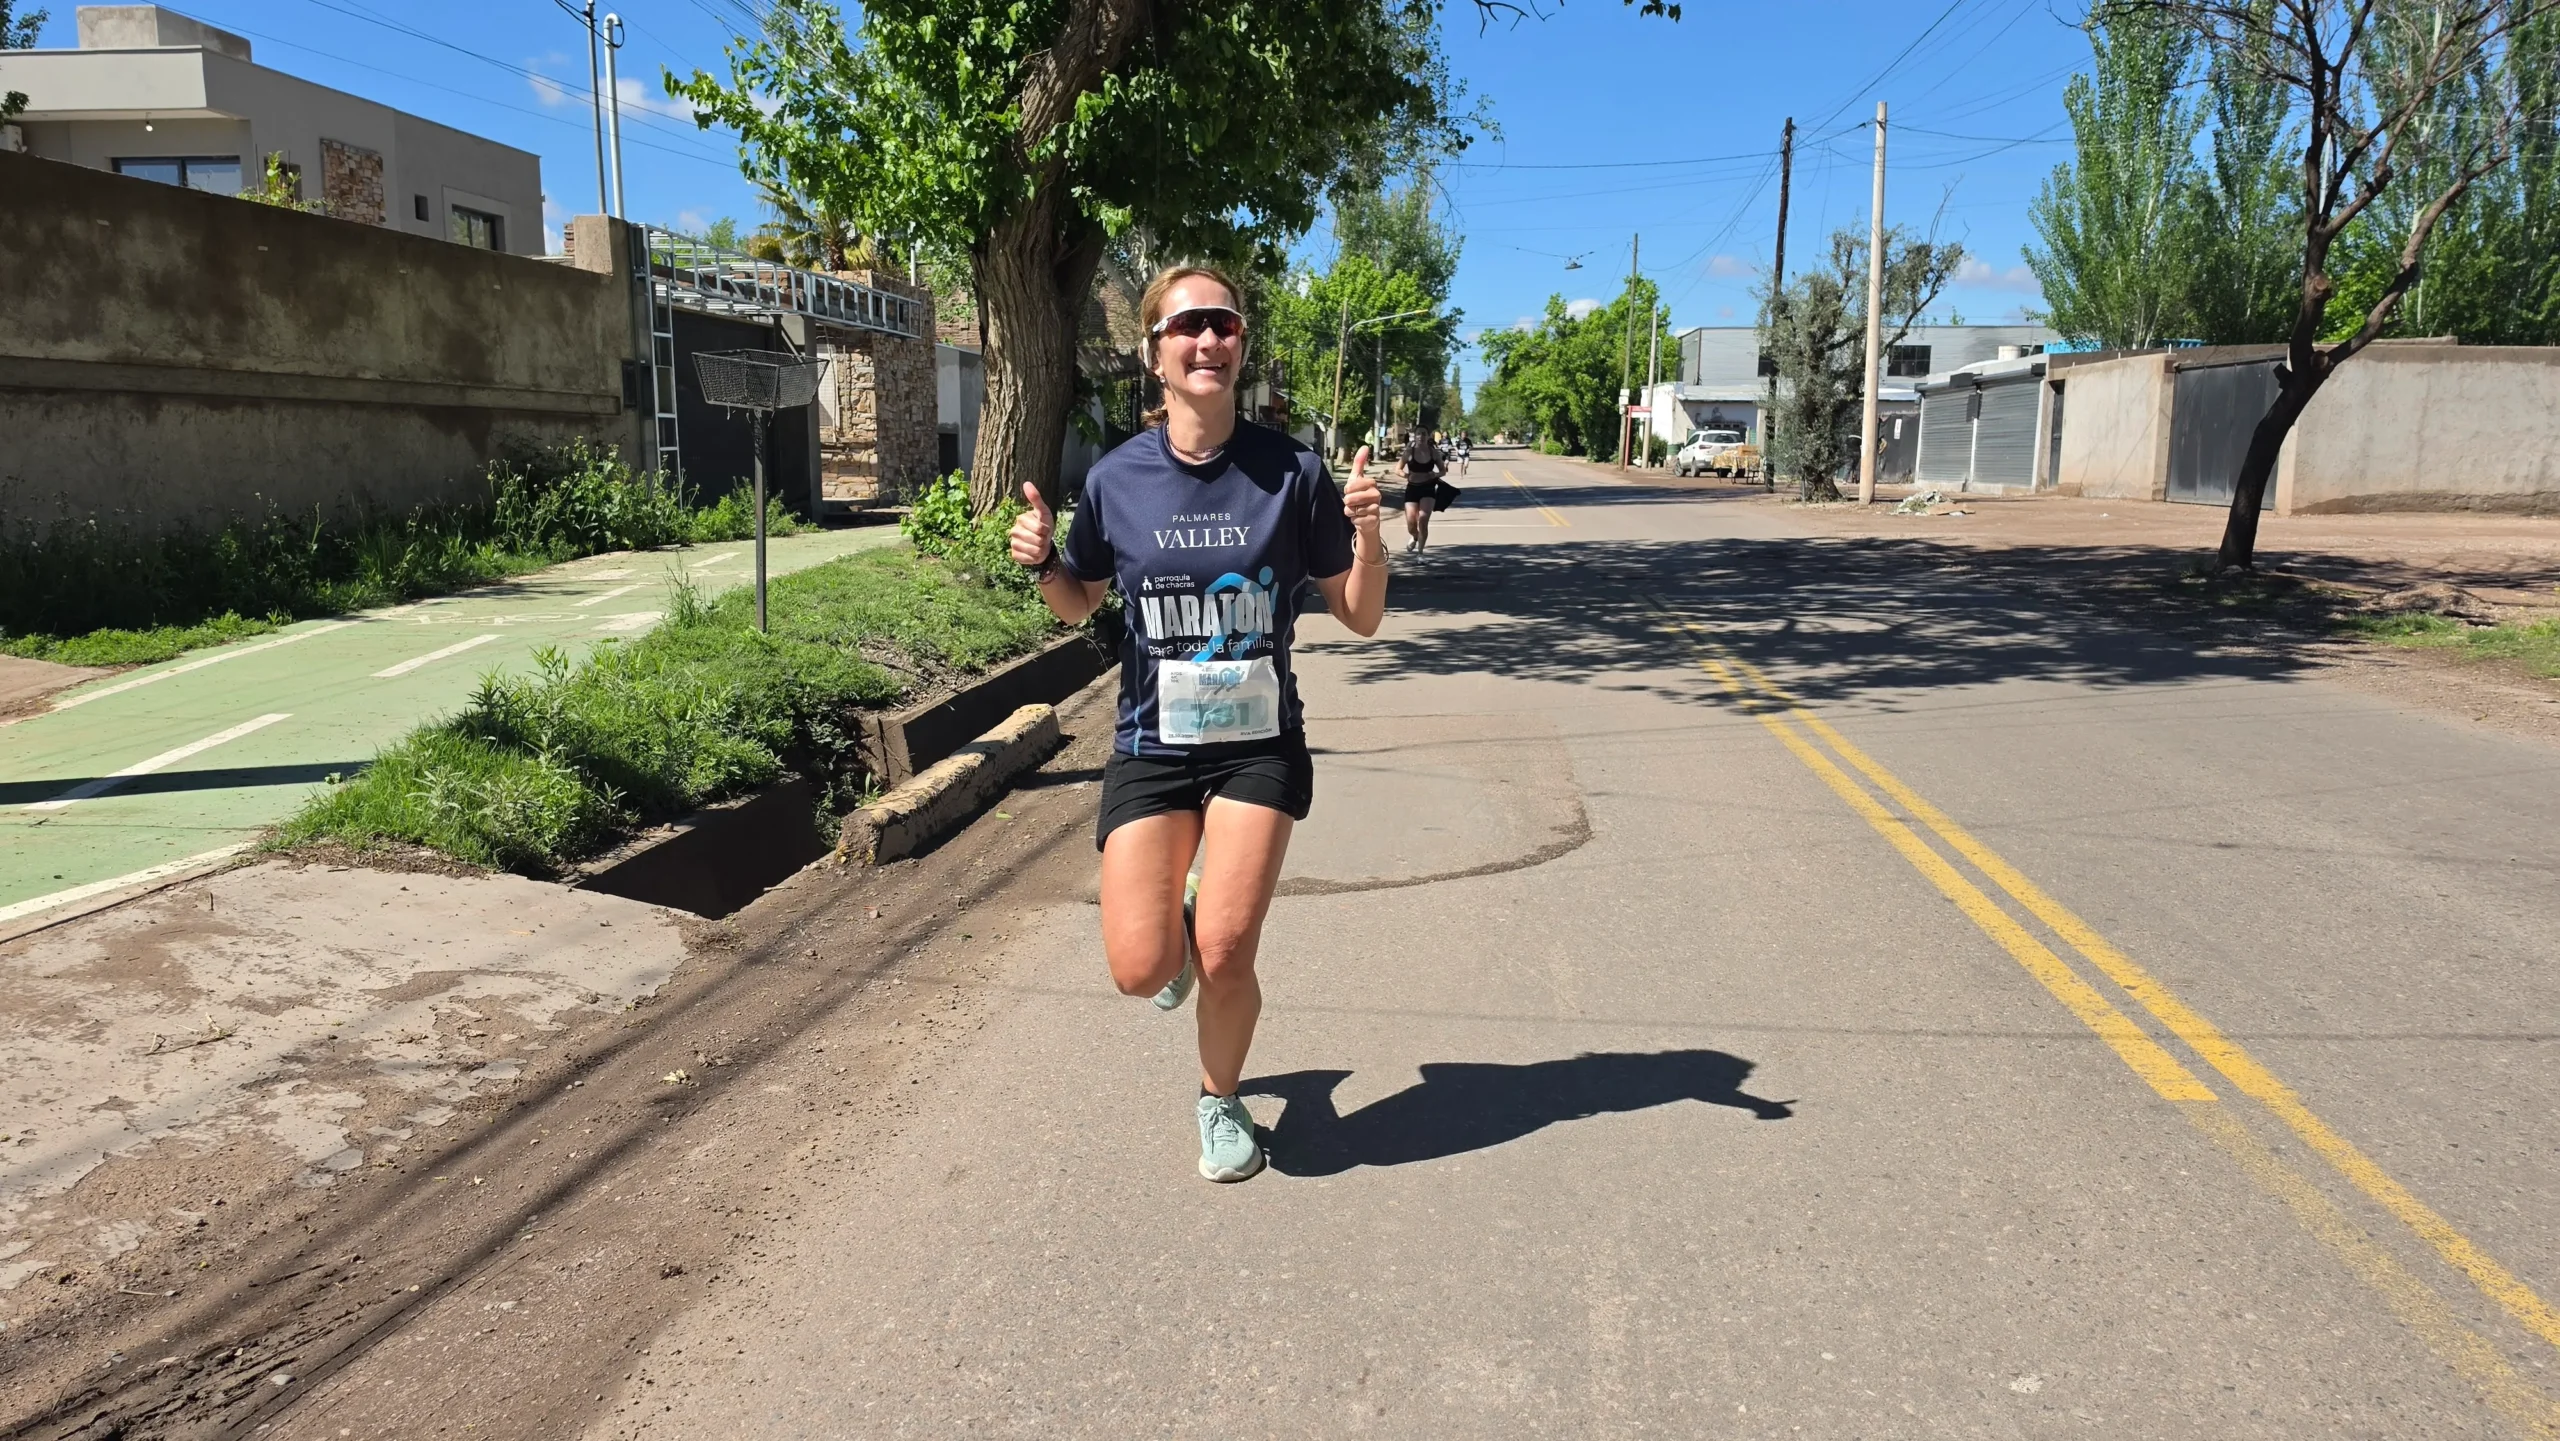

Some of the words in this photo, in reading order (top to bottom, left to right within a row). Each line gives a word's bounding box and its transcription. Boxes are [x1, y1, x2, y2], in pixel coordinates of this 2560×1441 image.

[1172, 512, 1231, 523] PALMARES
[1153, 526, 1251, 549] VALLEY
[1154, 574, 1191, 583] parroquia
[1166, 581, 1195, 589] chacras
[1139, 581, 1274, 640] MARATÓN
[1148, 645, 1174, 657] para
[1176, 640, 1209, 652] toda
[1212, 641, 1225, 653] la
[1228, 636, 1274, 652] familia
